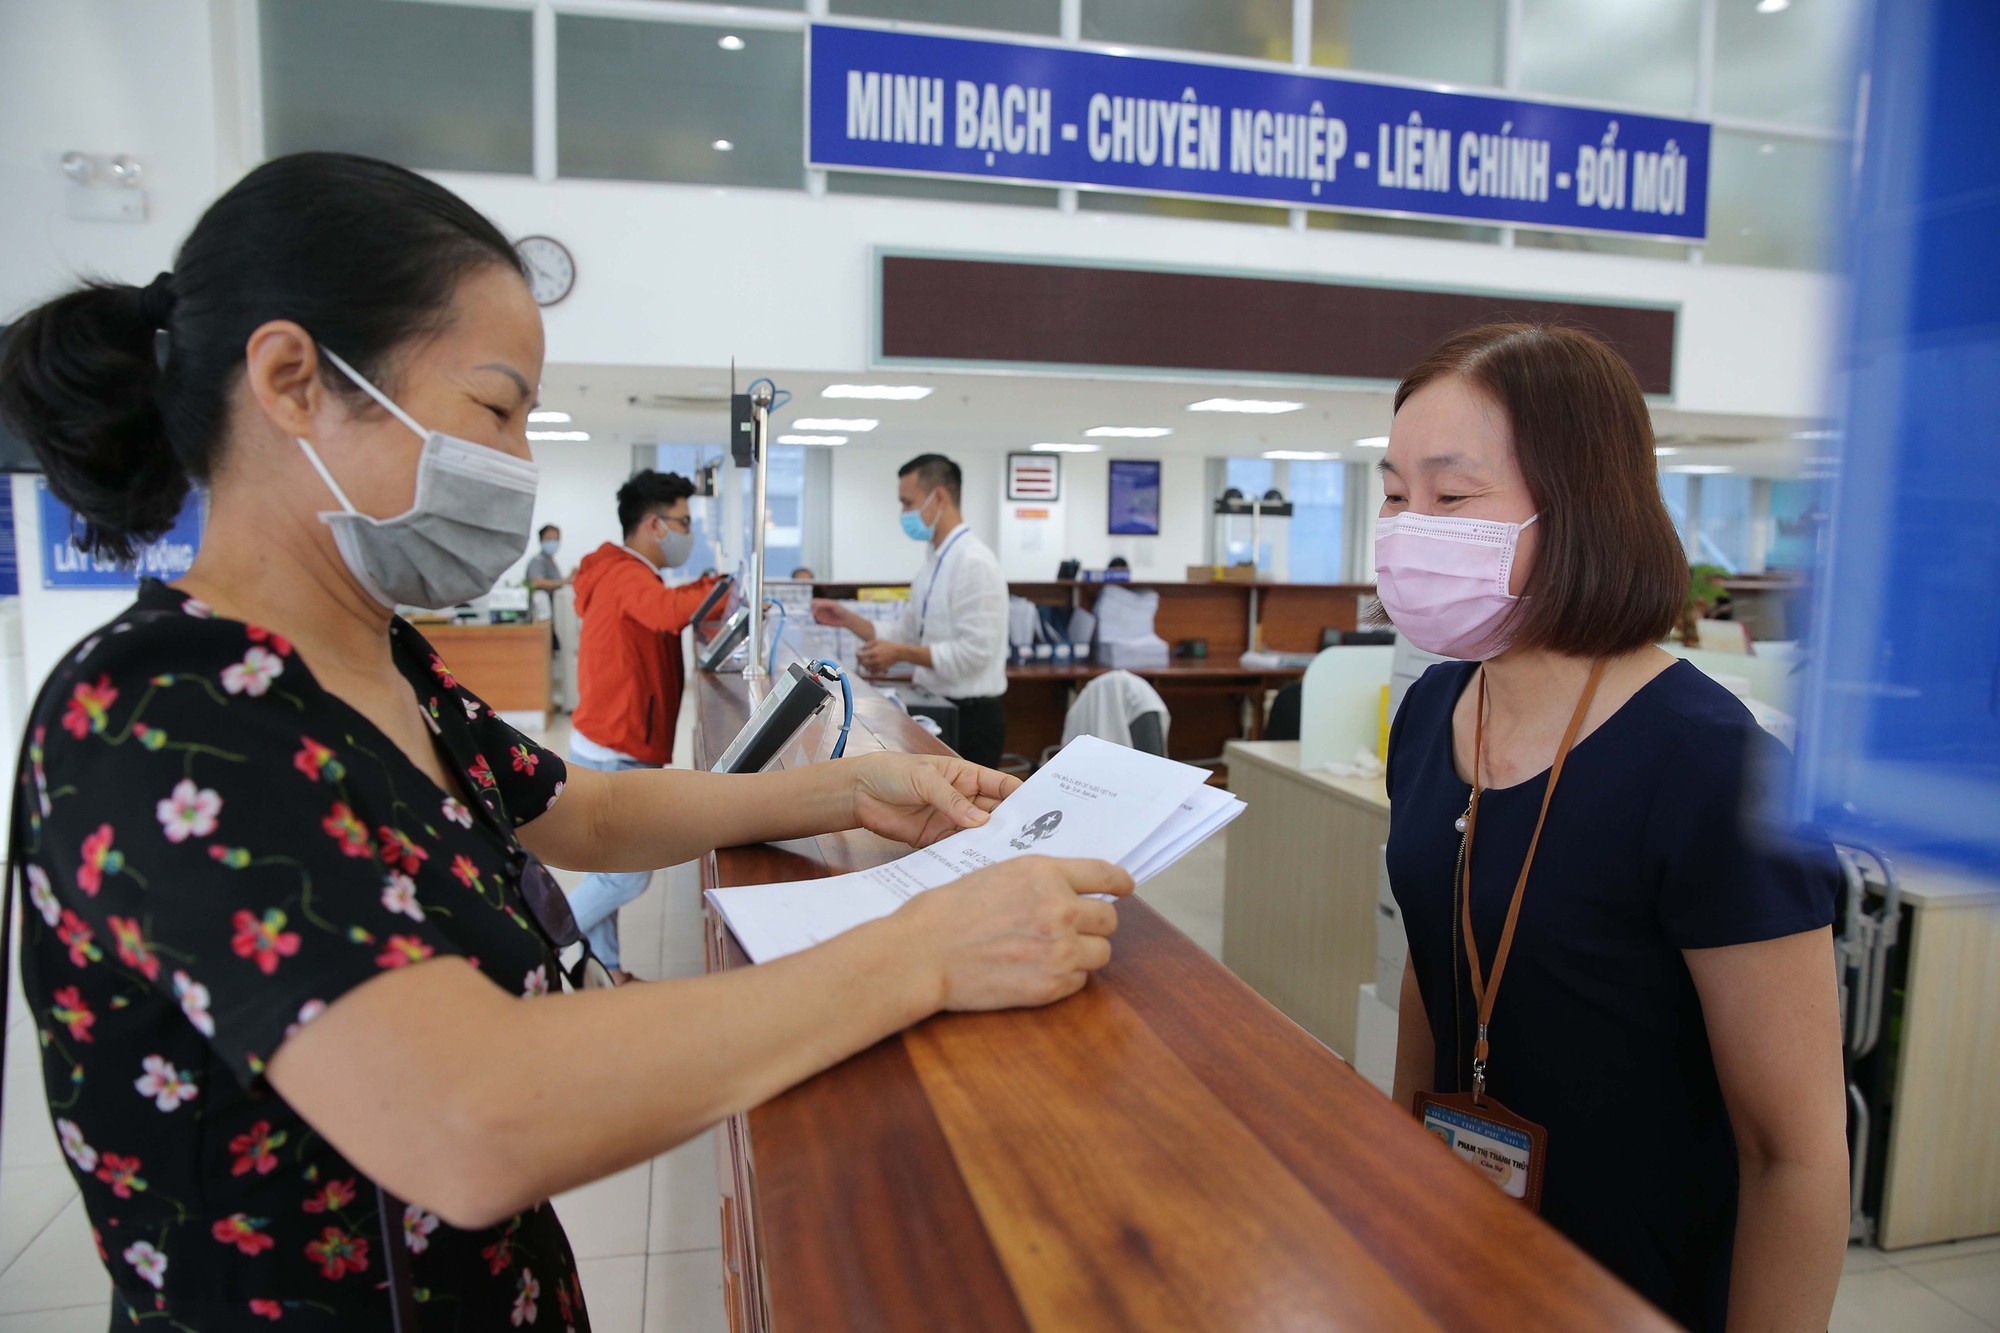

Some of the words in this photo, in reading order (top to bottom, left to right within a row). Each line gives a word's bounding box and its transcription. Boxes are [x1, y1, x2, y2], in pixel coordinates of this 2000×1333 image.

[846, 70, 943, 147] MINH
[955, 80, 1051, 167] BẠCH
[1061, 124, 1078, 141] -
[1088, 87, 1221, 172] CHUYÊN
[1230, 100, 1347, 196] NGHIỆP
[1354, 152, 1370, 168] -
[1378, 111, 1451, 192] LIÊM
[1458, 121, 1550, 202] CHÍNH
[1555, 172, 1571, 189] -
[1576, 120, 1627, 210] ĐỔI
[1632, 138, 1687, 216] MỚI
[1457, 1140, 1476, 1152] PHẠM
[1477, 1147, 1488, 1159] THỊ
[1489, 1151, 1511, 1165] THANH
